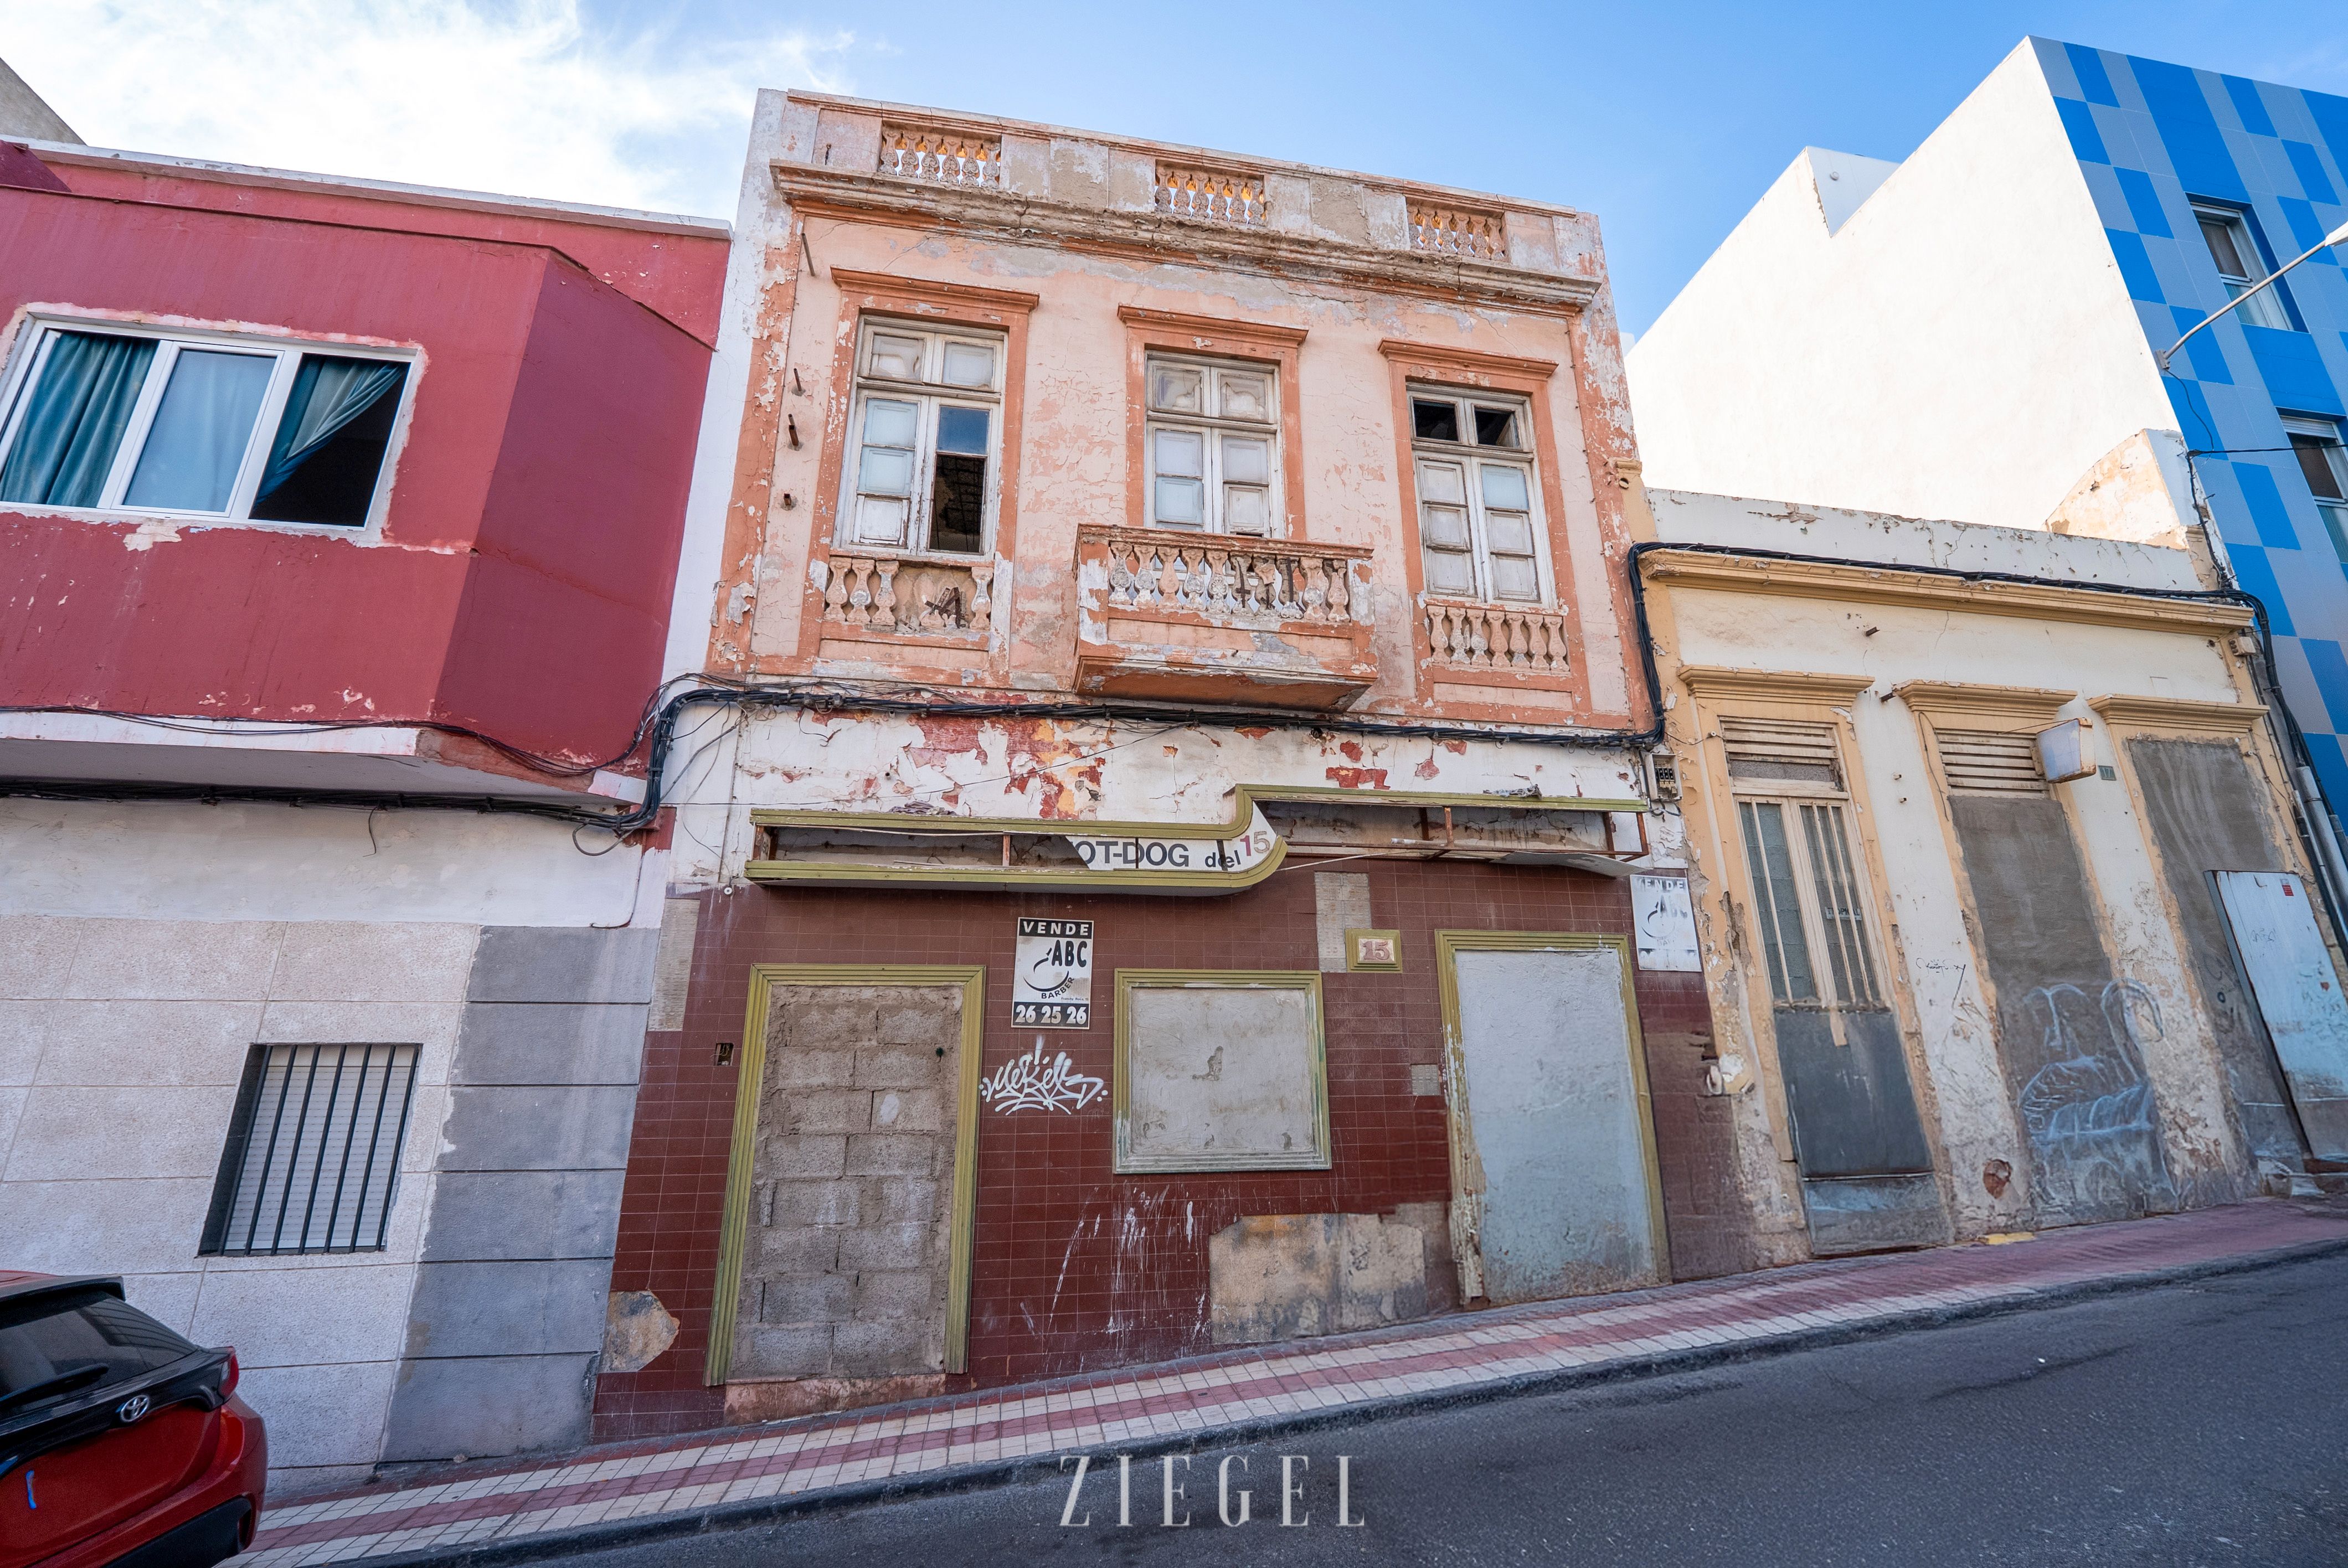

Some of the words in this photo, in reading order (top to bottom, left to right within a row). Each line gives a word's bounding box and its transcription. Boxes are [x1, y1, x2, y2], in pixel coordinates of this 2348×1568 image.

[1071, 840, 1190, 868] OT-DOG
[1204, 849, 1242, 868] del
[1240, 831, 1270, 857] 15
[1023, 921, 1089, 936] VENDE
[1051, 940, 1088, 968] ABC
[1363, 941, 1390, 960] 15
[1041, 977, 1075, 999] BARBER
[1015, 1004, 1036, 1023] 26
[1041, 1005, 1062, 1024] 25
[1066, 1006, 1087, 1025] 26
